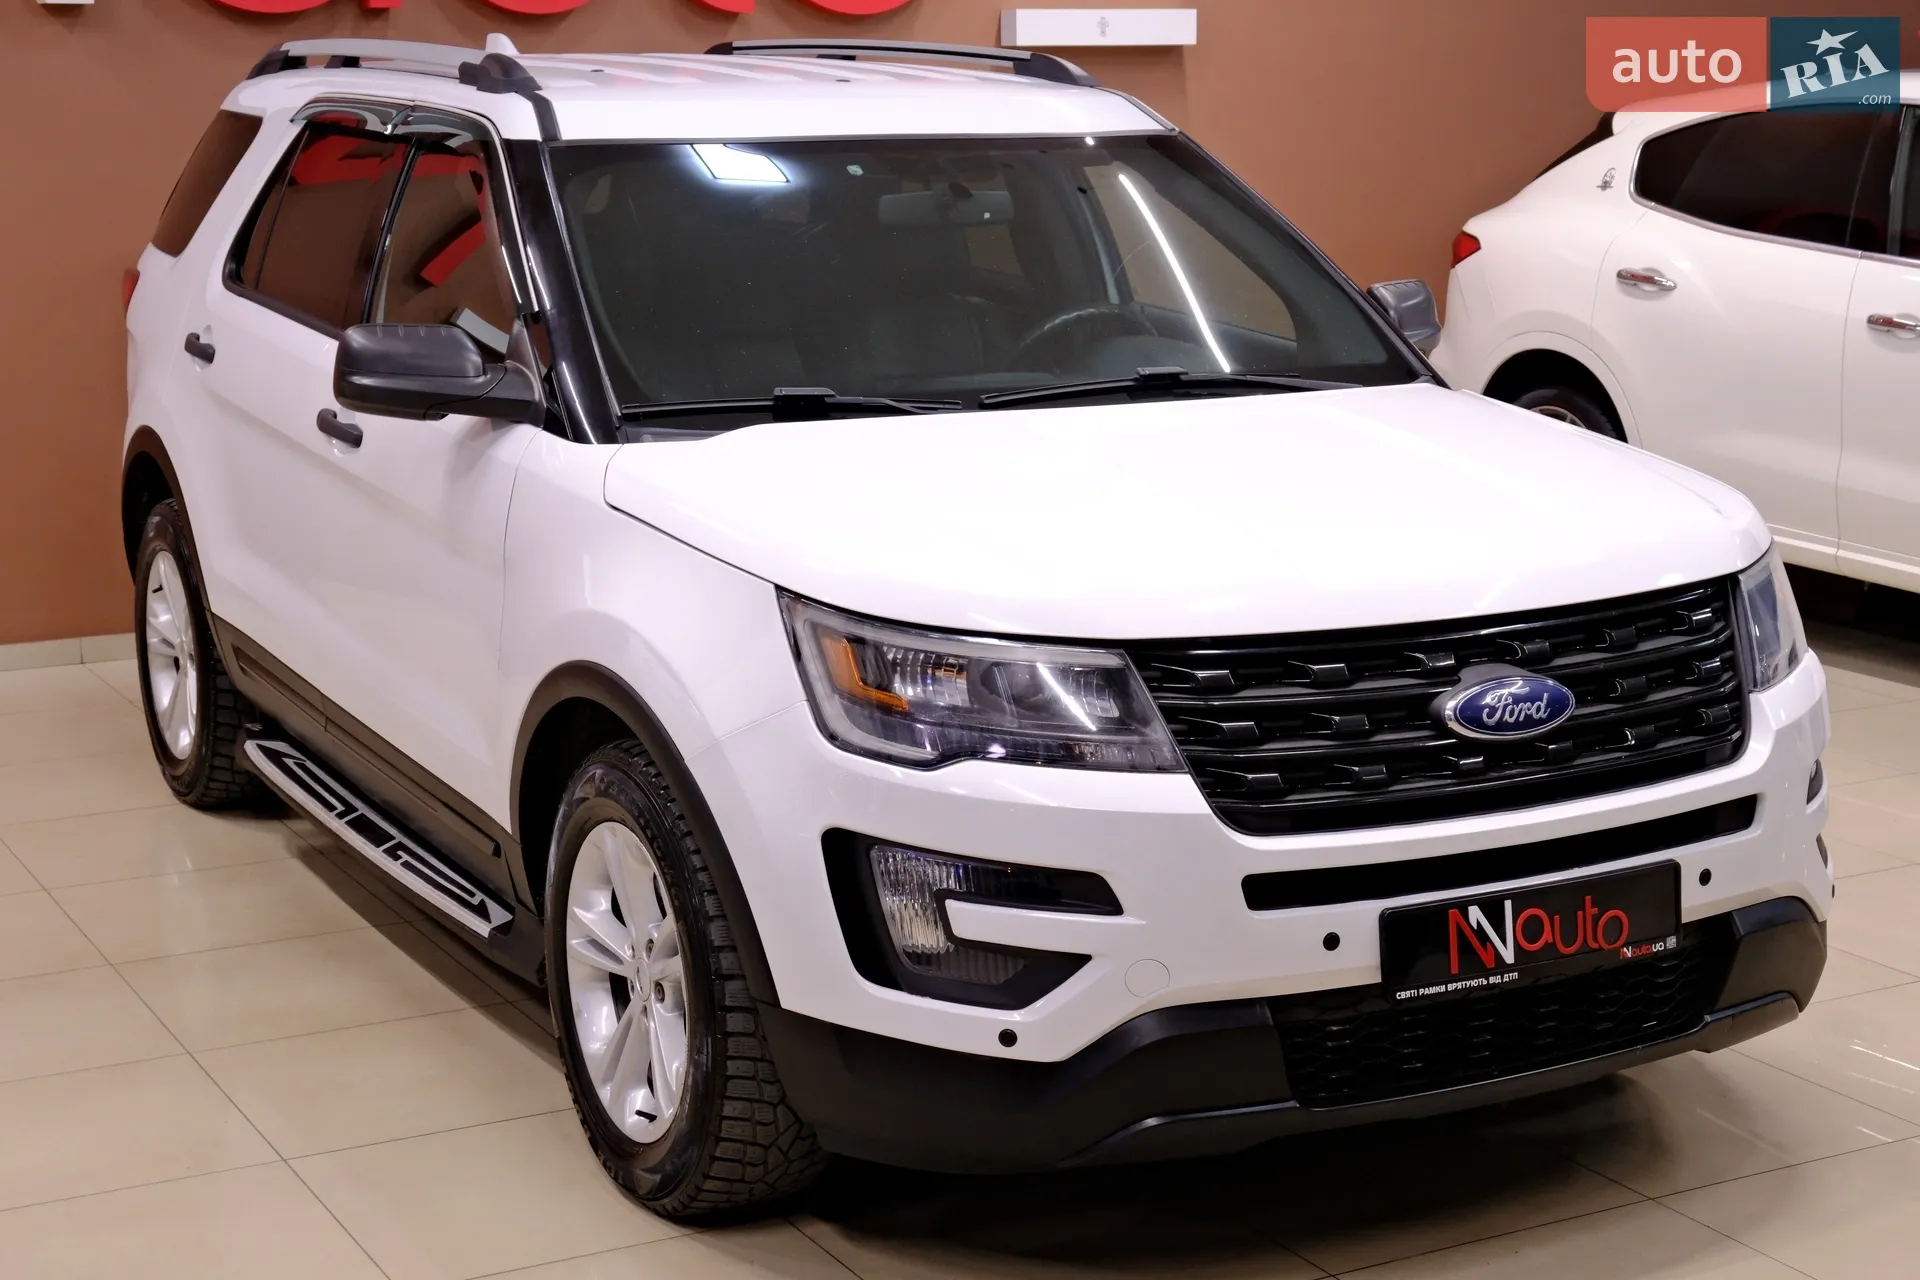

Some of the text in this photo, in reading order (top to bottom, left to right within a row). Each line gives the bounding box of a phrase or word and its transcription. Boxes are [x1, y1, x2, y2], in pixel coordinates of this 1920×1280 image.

[1482, 680, 1551, 726] Ford
[1396, 972, 1518, 1000] СВЯТІ РАМКИ ВРЯТУЮТЬ ВІД ДТП
